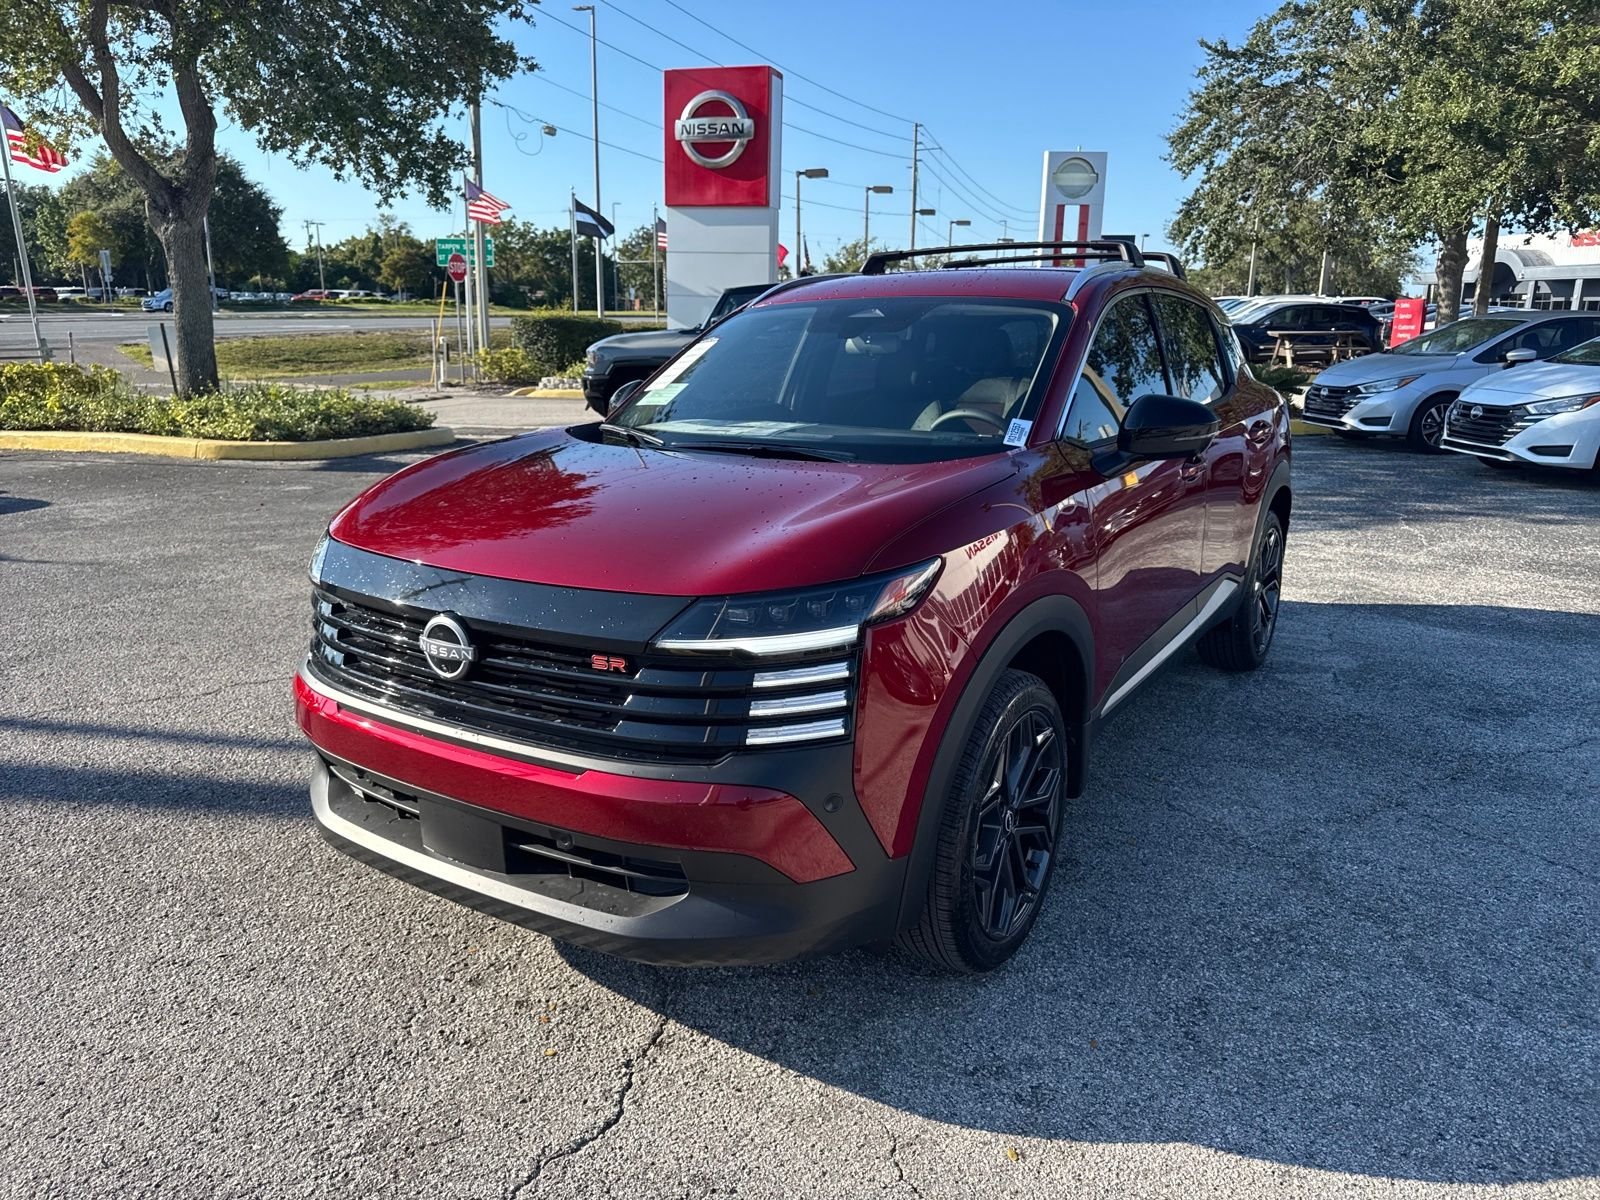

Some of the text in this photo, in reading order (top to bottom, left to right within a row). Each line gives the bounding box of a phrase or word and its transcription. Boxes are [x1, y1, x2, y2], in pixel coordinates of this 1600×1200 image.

[681, 123, 744, 135] NISSAN
[450, 262, 466, 273] STOP
[419, 636, 472, 660] NISSAN
[591, 654, 626, 673] SR
